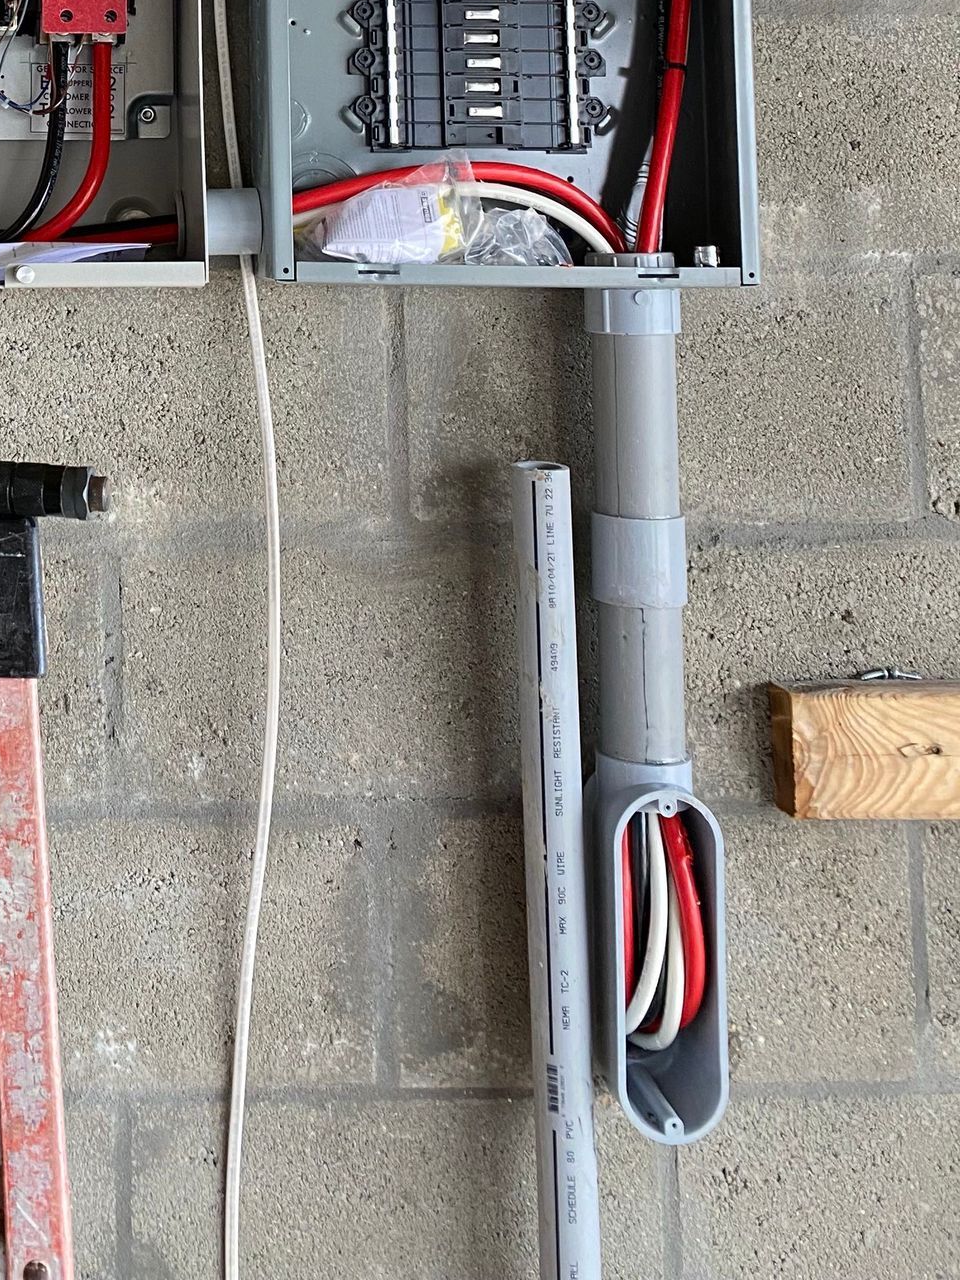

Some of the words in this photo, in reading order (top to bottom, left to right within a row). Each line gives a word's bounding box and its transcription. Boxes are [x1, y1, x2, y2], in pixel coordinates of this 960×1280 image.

[545, 486, 554, 500] 22
[546, 521, 556, 546] LINE
[550, 642, 559, 672] 49409
[553, 705, 561, 760] RESISTANT
[555, 769, 564, 817] SUNLIGHT
[558, 885, 567, 906] 90C
[559, 916, 567, 936] MAX
[560, 969, 569, 995] TC-2
[561, 1005, 570, 1031] NEMA
[566, 1121, 574, 1140] PVC
[567, 1150, 575, 1164] 80
[568, 1175, 576, 1225] SCHEDULE
